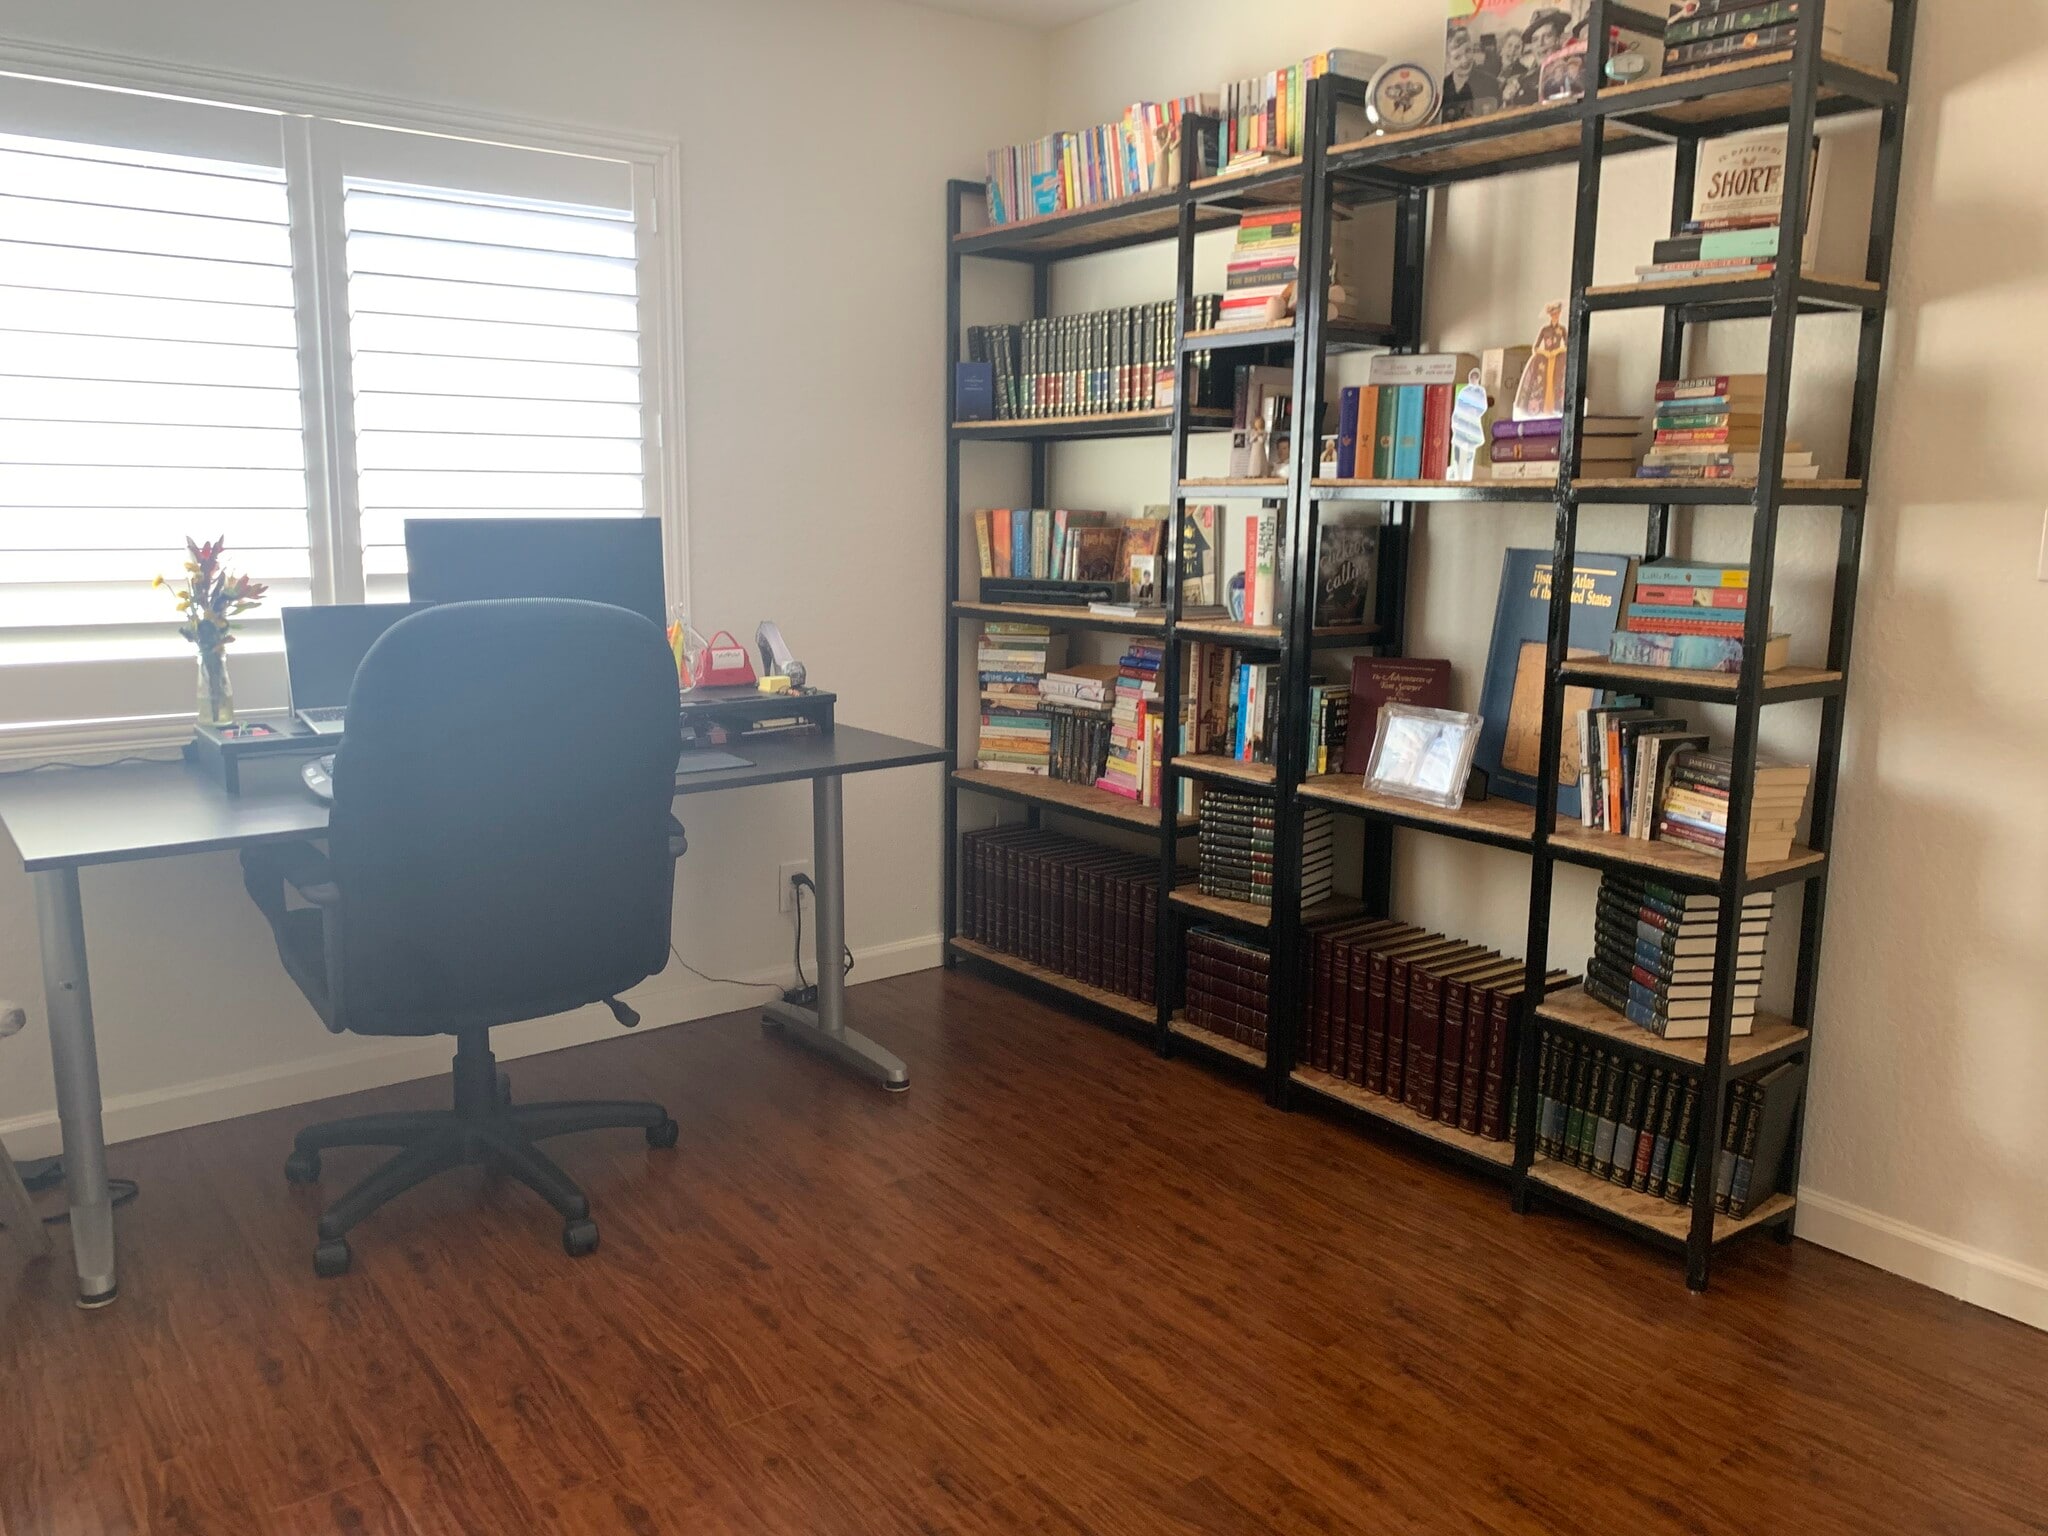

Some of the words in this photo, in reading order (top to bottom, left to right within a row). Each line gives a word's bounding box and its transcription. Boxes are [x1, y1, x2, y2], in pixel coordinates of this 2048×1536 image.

[1244, 272, 1282, 283] BRETHREN
[1258, 521, 1267, 558] WHITE
[1266, 516, 1276, 553] LETHAL
[1573, 573, 1595, 589] Atlas
[1530, 584, 1540, 599] of
[1586, 590, 1612, 607] States
[1382, 671, 1426, 683] Adventures
[1425, 677, 1433, 685] of
[1380, 681, 1395, 689] Tom
[1395, 681, 1423, 692] Sawyer
